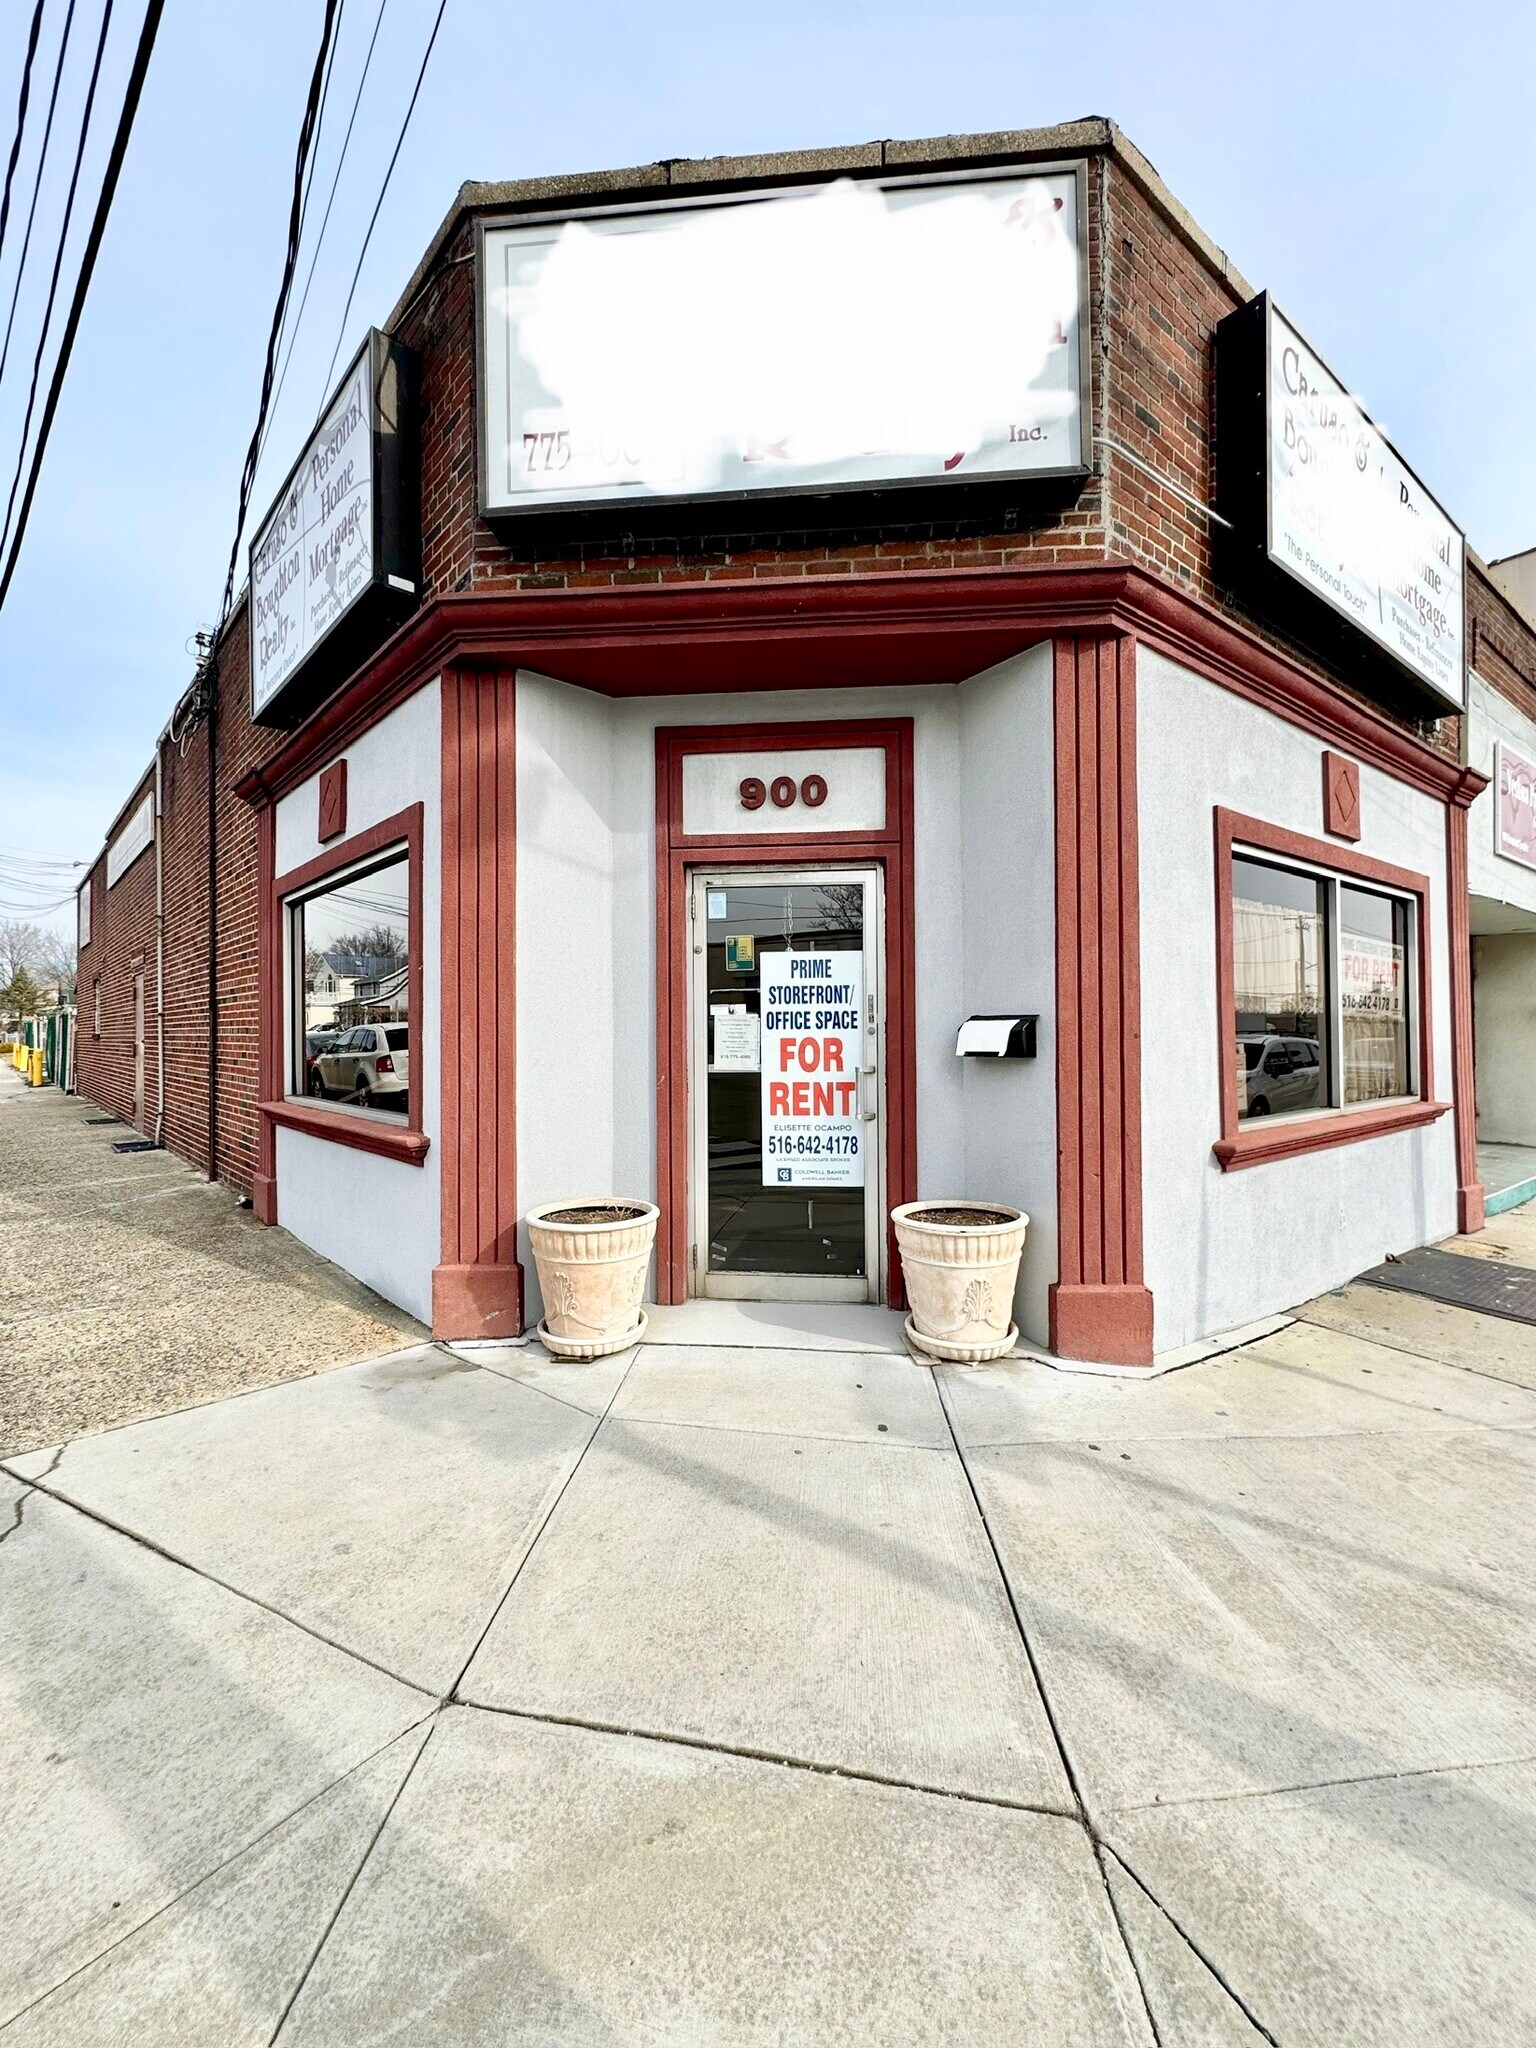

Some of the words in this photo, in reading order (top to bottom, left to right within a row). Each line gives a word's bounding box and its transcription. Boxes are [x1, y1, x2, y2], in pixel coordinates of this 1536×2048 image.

[311, 379, 363, 494] Personal
[1009, 424, 1048, 444] Inc.
[320, 458, 354, 527] Home
[255, 519, 288, 585] Caruso
[308, 495, 362, 588] Mortgage
[256, 550, 300, 628] Boughton
[1304, 551, 1342, 594] Personal
[259, 613, 289, 671] Realty
[1391, 606, 1420, 643] Purchases
[1399, 630, 1416, 657] Home
[739, 774, 828, 811] 900
[790, 958, 832, 979] PRIME
[1344, 954, 1369, 982] FOR
[768, 984, 855, 1006] STOREFRONT/
[766, 1010, 811, 1030] OFFICE
[815, 1010, 858, 1030] SPACE
[780, 1037, 844, 1073] FOR
[769, 1081, 856, 1116] RENT
[774, 1124, 812, 1132] ELISETTE
[814, 1124, 852, 1132] OCAMPO
